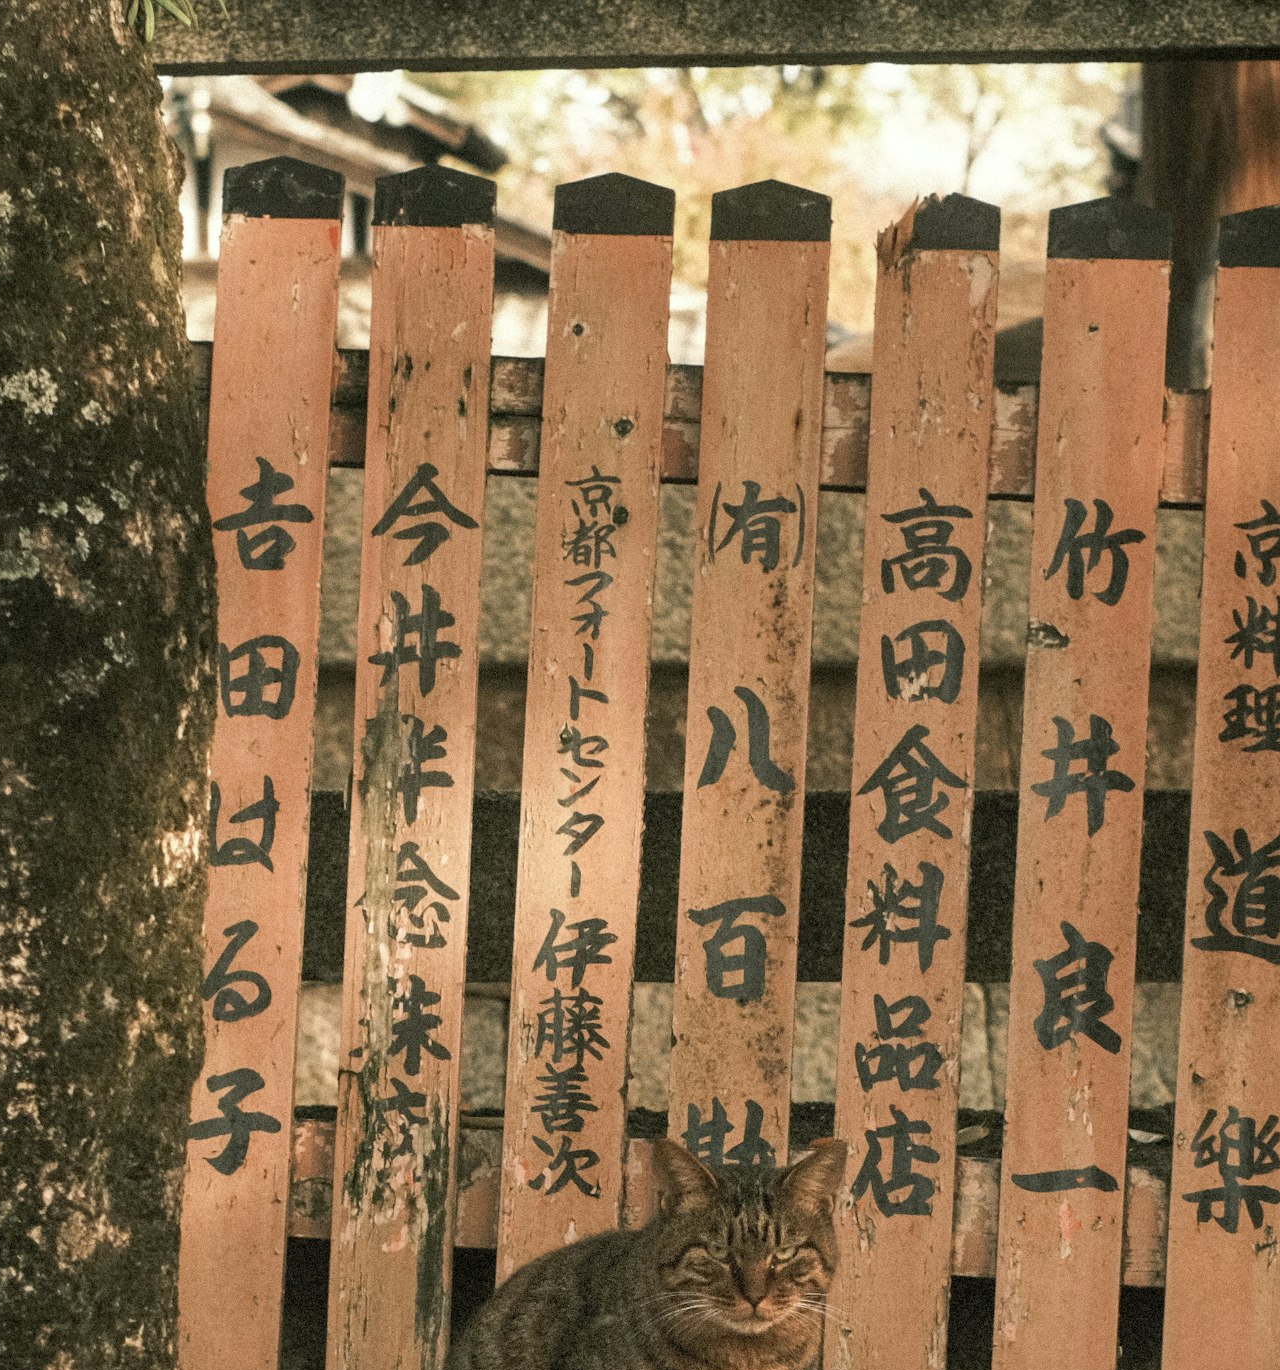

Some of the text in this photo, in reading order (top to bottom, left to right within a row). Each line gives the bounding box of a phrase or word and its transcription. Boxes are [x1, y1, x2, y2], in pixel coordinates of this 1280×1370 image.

[849, 487, 974, 1218] 高田食料品店
[1012, 498, 1147, 1193] 竹井良一
